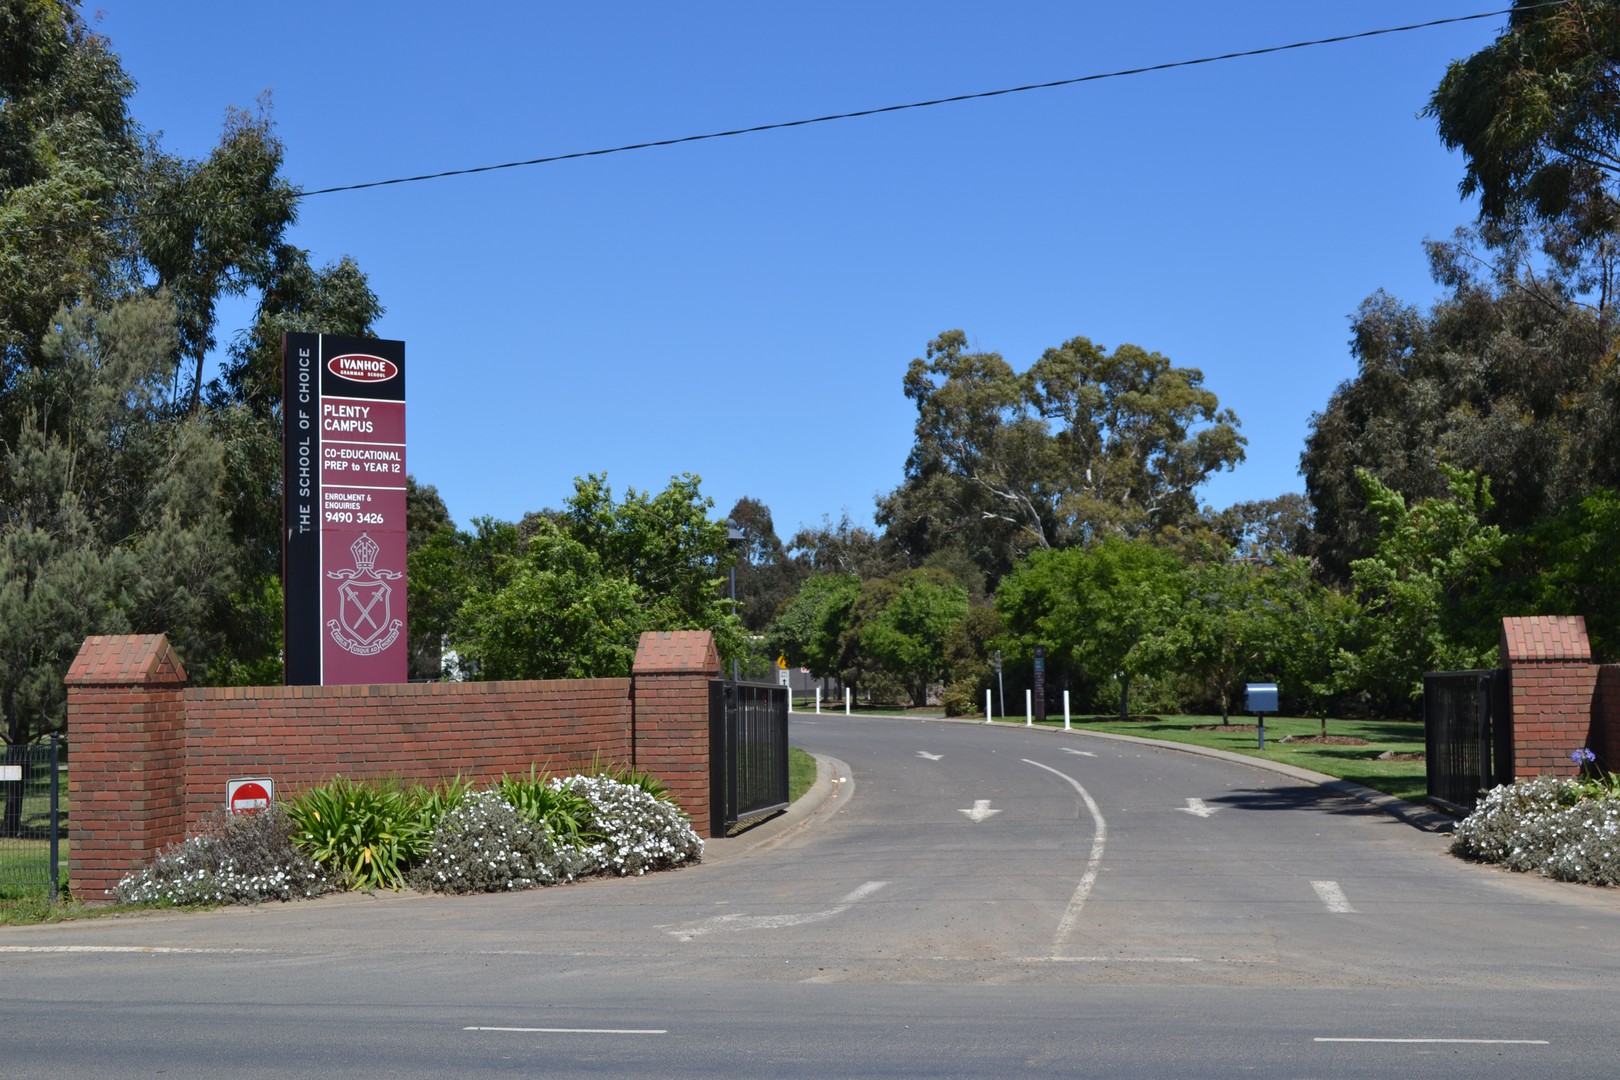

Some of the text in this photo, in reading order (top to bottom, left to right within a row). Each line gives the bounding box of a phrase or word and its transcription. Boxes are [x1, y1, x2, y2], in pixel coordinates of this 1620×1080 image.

[340, 358, 386, 372] IVANHOE
[324, 404, 370, 418] PLENTY
[324, 418, 374, 433] CAMPUS
[299, 347, 311, 534] THE SCHOOL OF CHOICE
[324, 448, 401, 461] CO-EDUCATIONAL
[324, 461, 400, 473] PREP to YEAR 12
[324, 492, 365, 502] ENROLMENT
[324, 502, 361, 510] ENQUIRIES
[325, 511, 384, 524] 9490 3426
